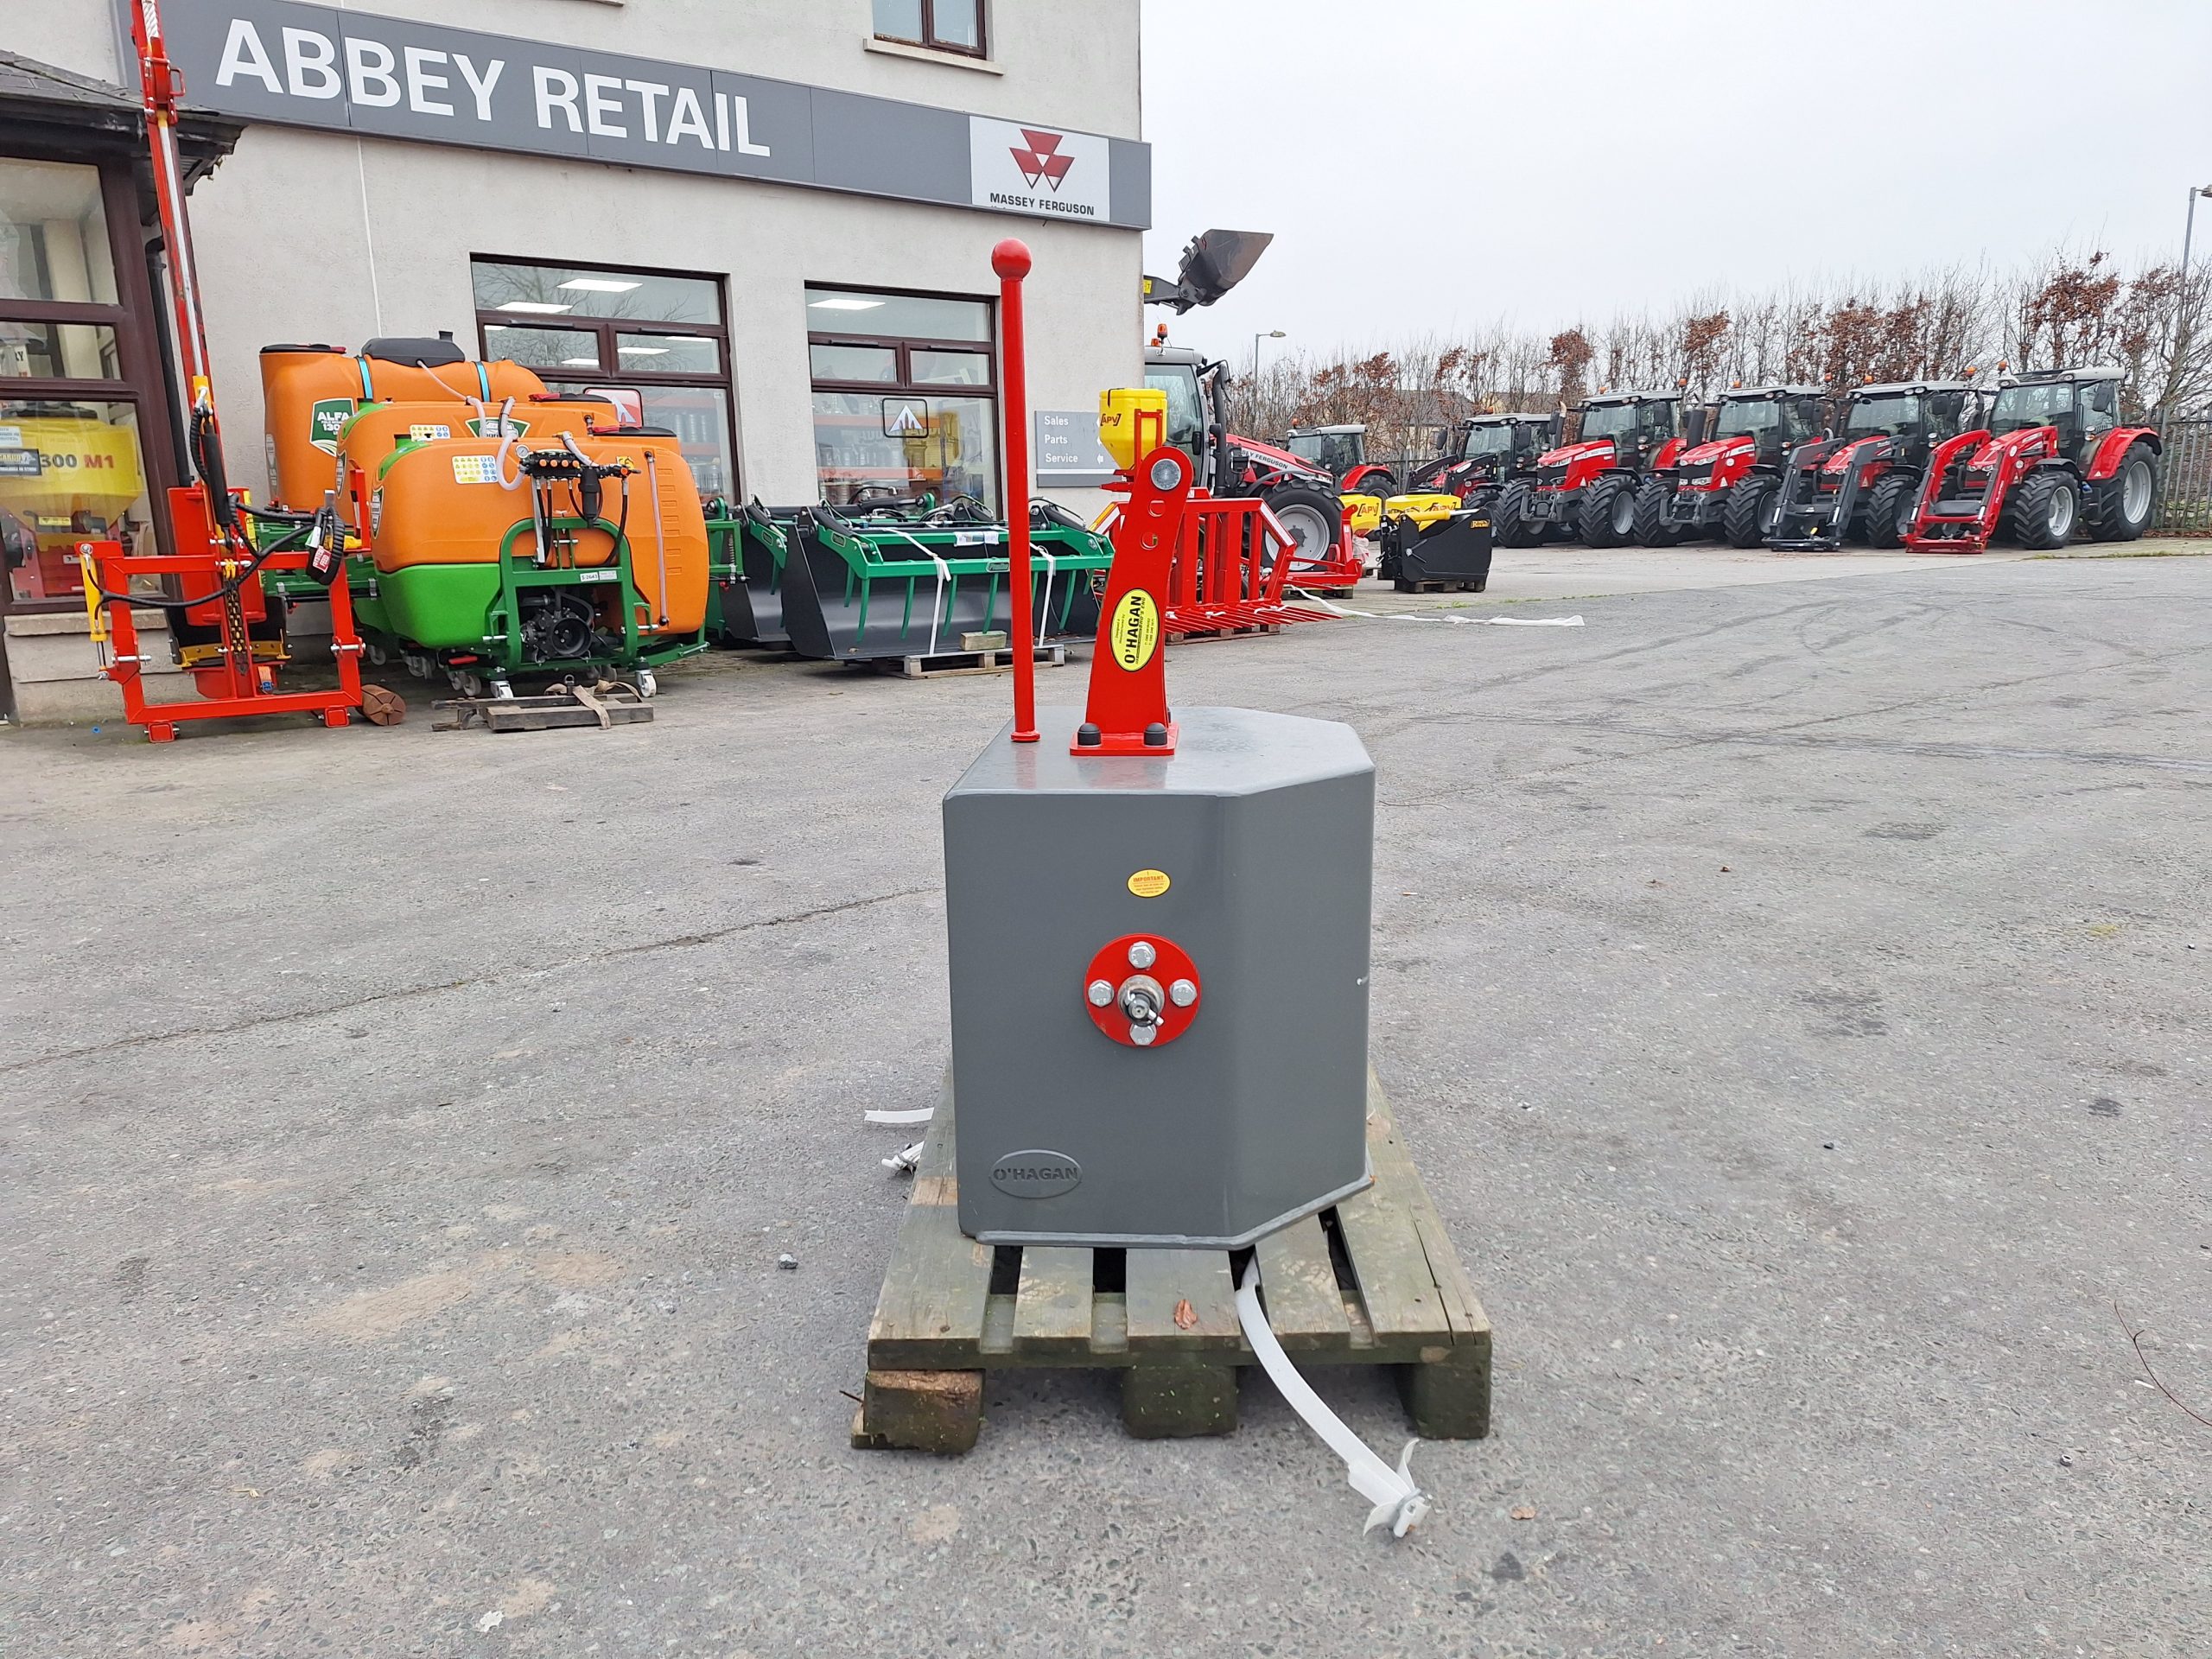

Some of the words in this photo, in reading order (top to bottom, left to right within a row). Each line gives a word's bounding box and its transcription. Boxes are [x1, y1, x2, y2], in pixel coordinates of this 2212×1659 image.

[215, 18, 505, 122] ABBEY
[532, 65, 771, 158] RETAIL
[990, 192, 1035, 208] MASSEY
[1039, 199, 1094, 216] FERGUSON
[317, 411, 349, 422] ALFA
[1044, 416, 1069, 426] Sales
[1044, 434, 1068, 444] Parts
[84, 454, 115, 468] M1
[1046, 453, 1078, 463] Service
[1255, 454, 1288, 470] FERGUSON
[1124, 595, 1142, 664] O'HAGAN
[993, 1167, 1078, 1181] O'HAGAN
